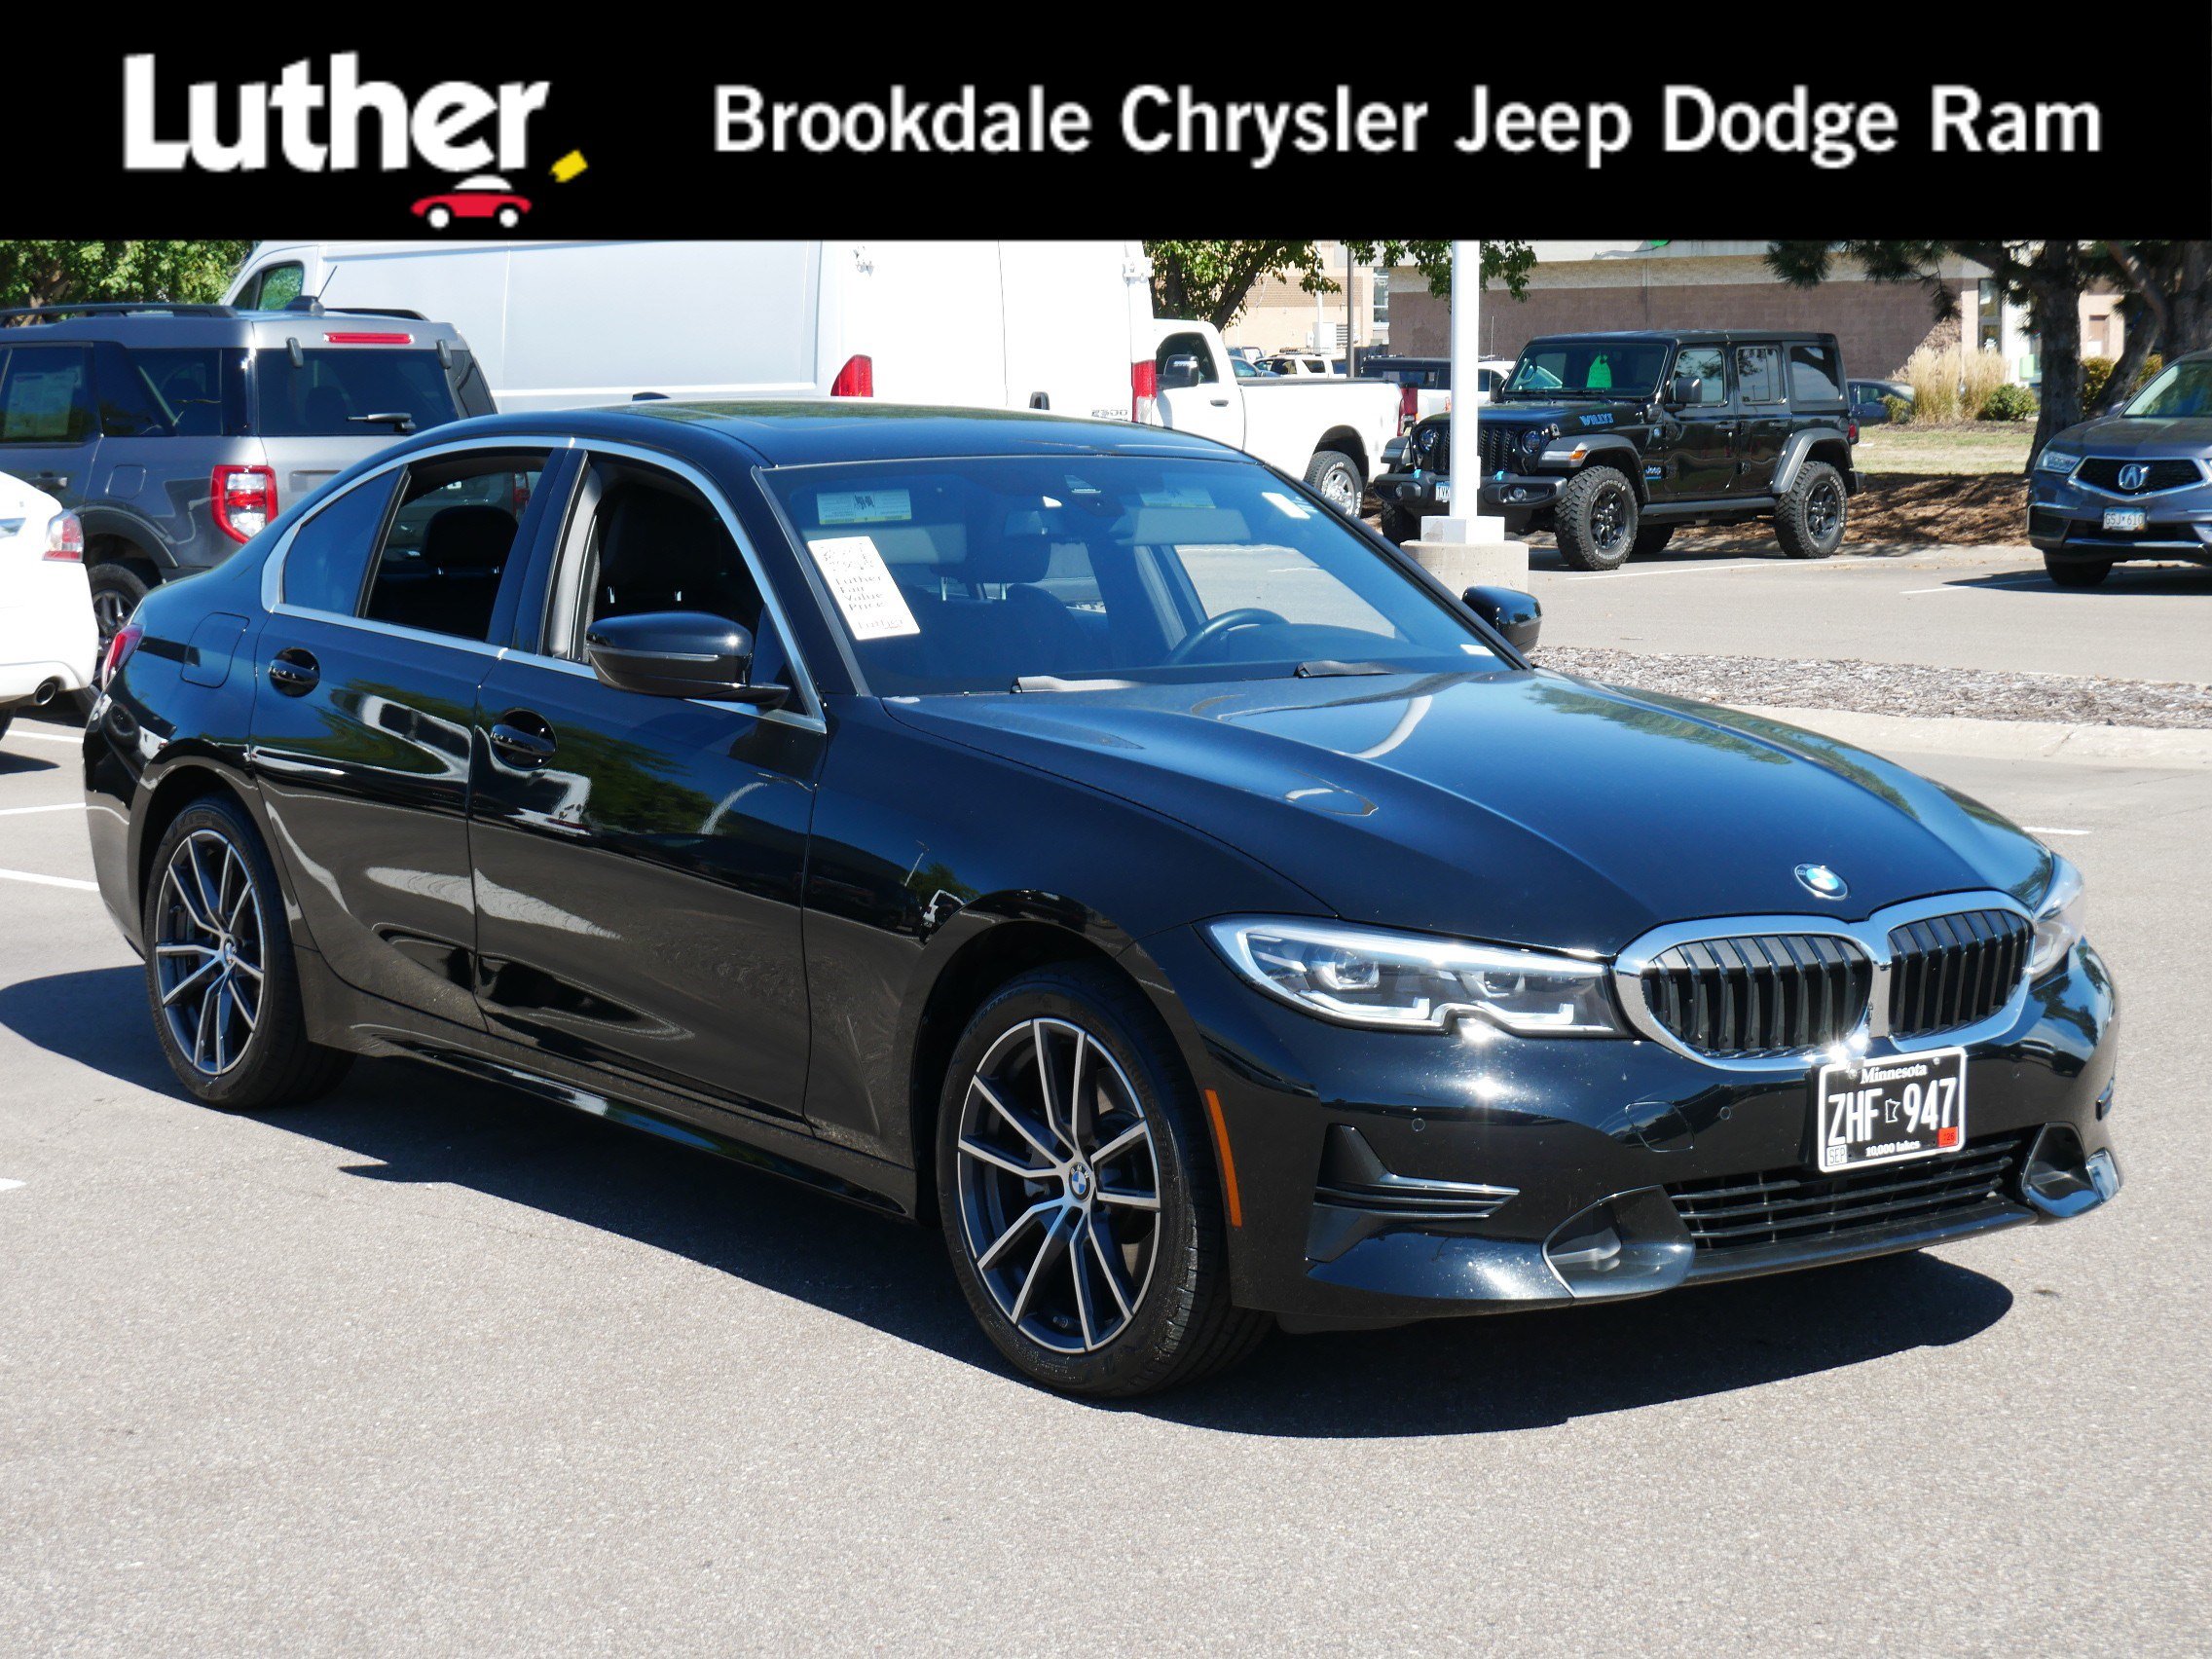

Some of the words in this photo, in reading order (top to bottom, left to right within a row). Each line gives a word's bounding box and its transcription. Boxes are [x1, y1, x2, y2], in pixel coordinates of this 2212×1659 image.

[1579, 412, 1614, 426] WILLYS
[1645, 464, 1662, 475] Jeep
[1860, 1063, 1928, 1085] Minnesota
[1826, 1088, 1885, 1146] ZHF
[1902, 1077, 1957, 1133] 947
[1828, 1147, 1846, 1164] SEP
[1864, 1143, 1895, 1158] 10,000
